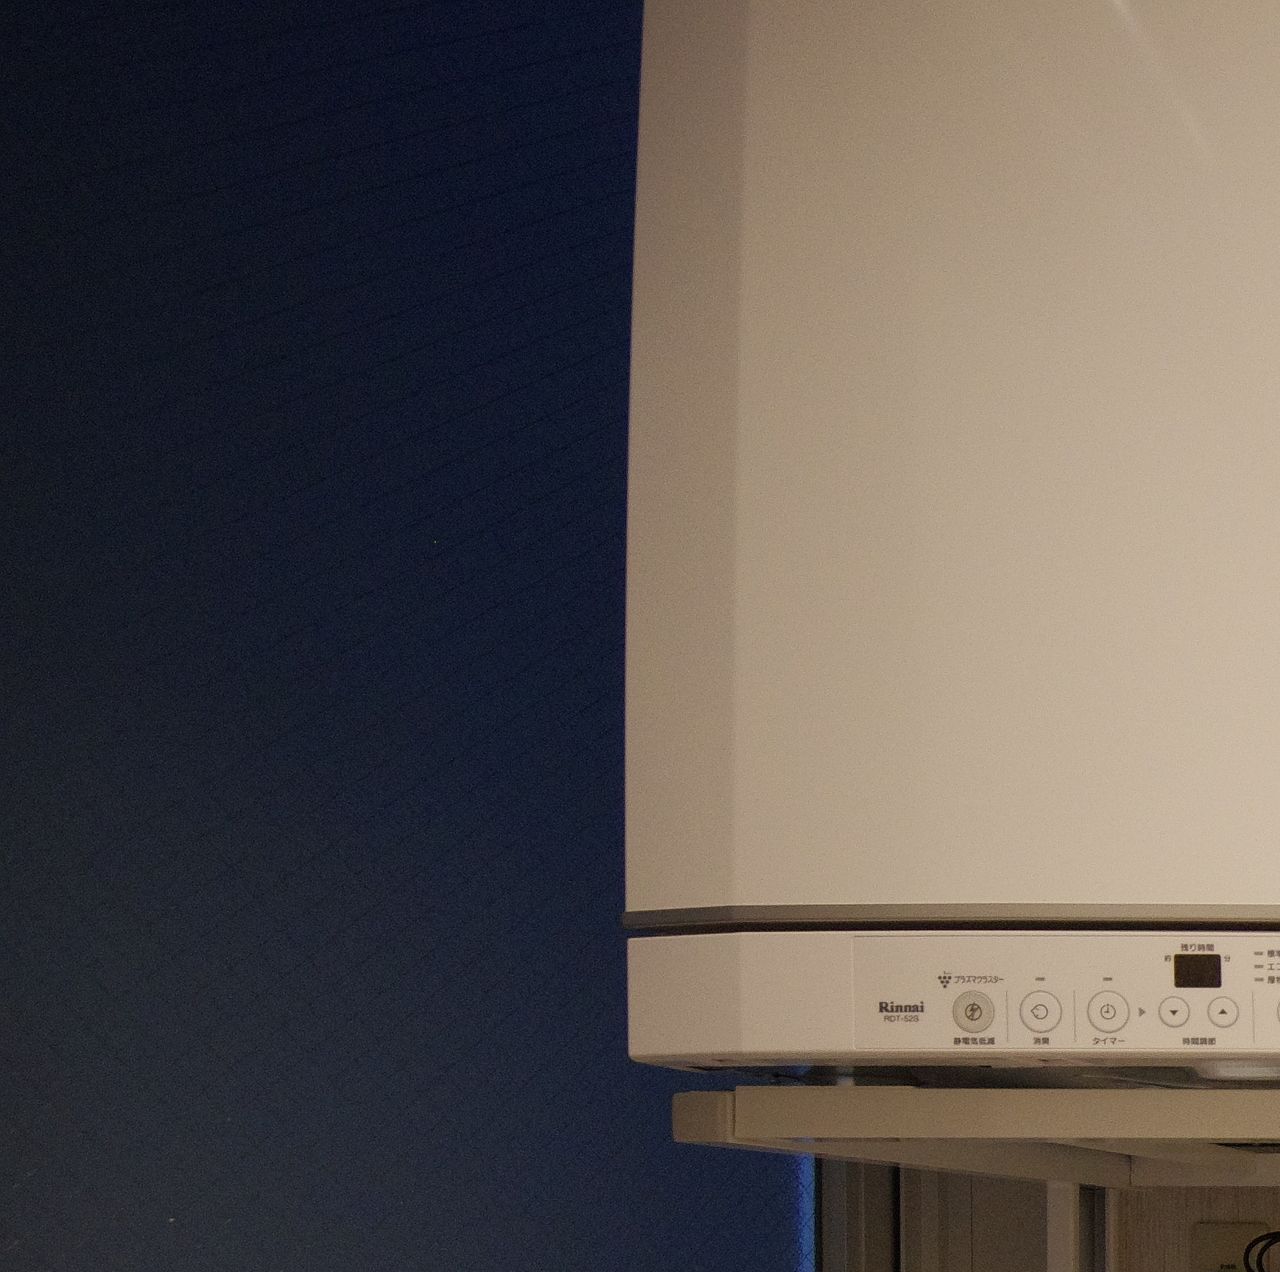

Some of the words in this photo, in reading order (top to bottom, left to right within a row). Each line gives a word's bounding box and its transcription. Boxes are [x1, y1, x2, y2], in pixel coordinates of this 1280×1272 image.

[1181, 943, 1215, 952] 残り時間
[953, 975, 1004, 984] プラズマクラスター
[878, 1001, 925, 1014] Rinnai
[1092, 1037, 1126, 1045] タイマー
